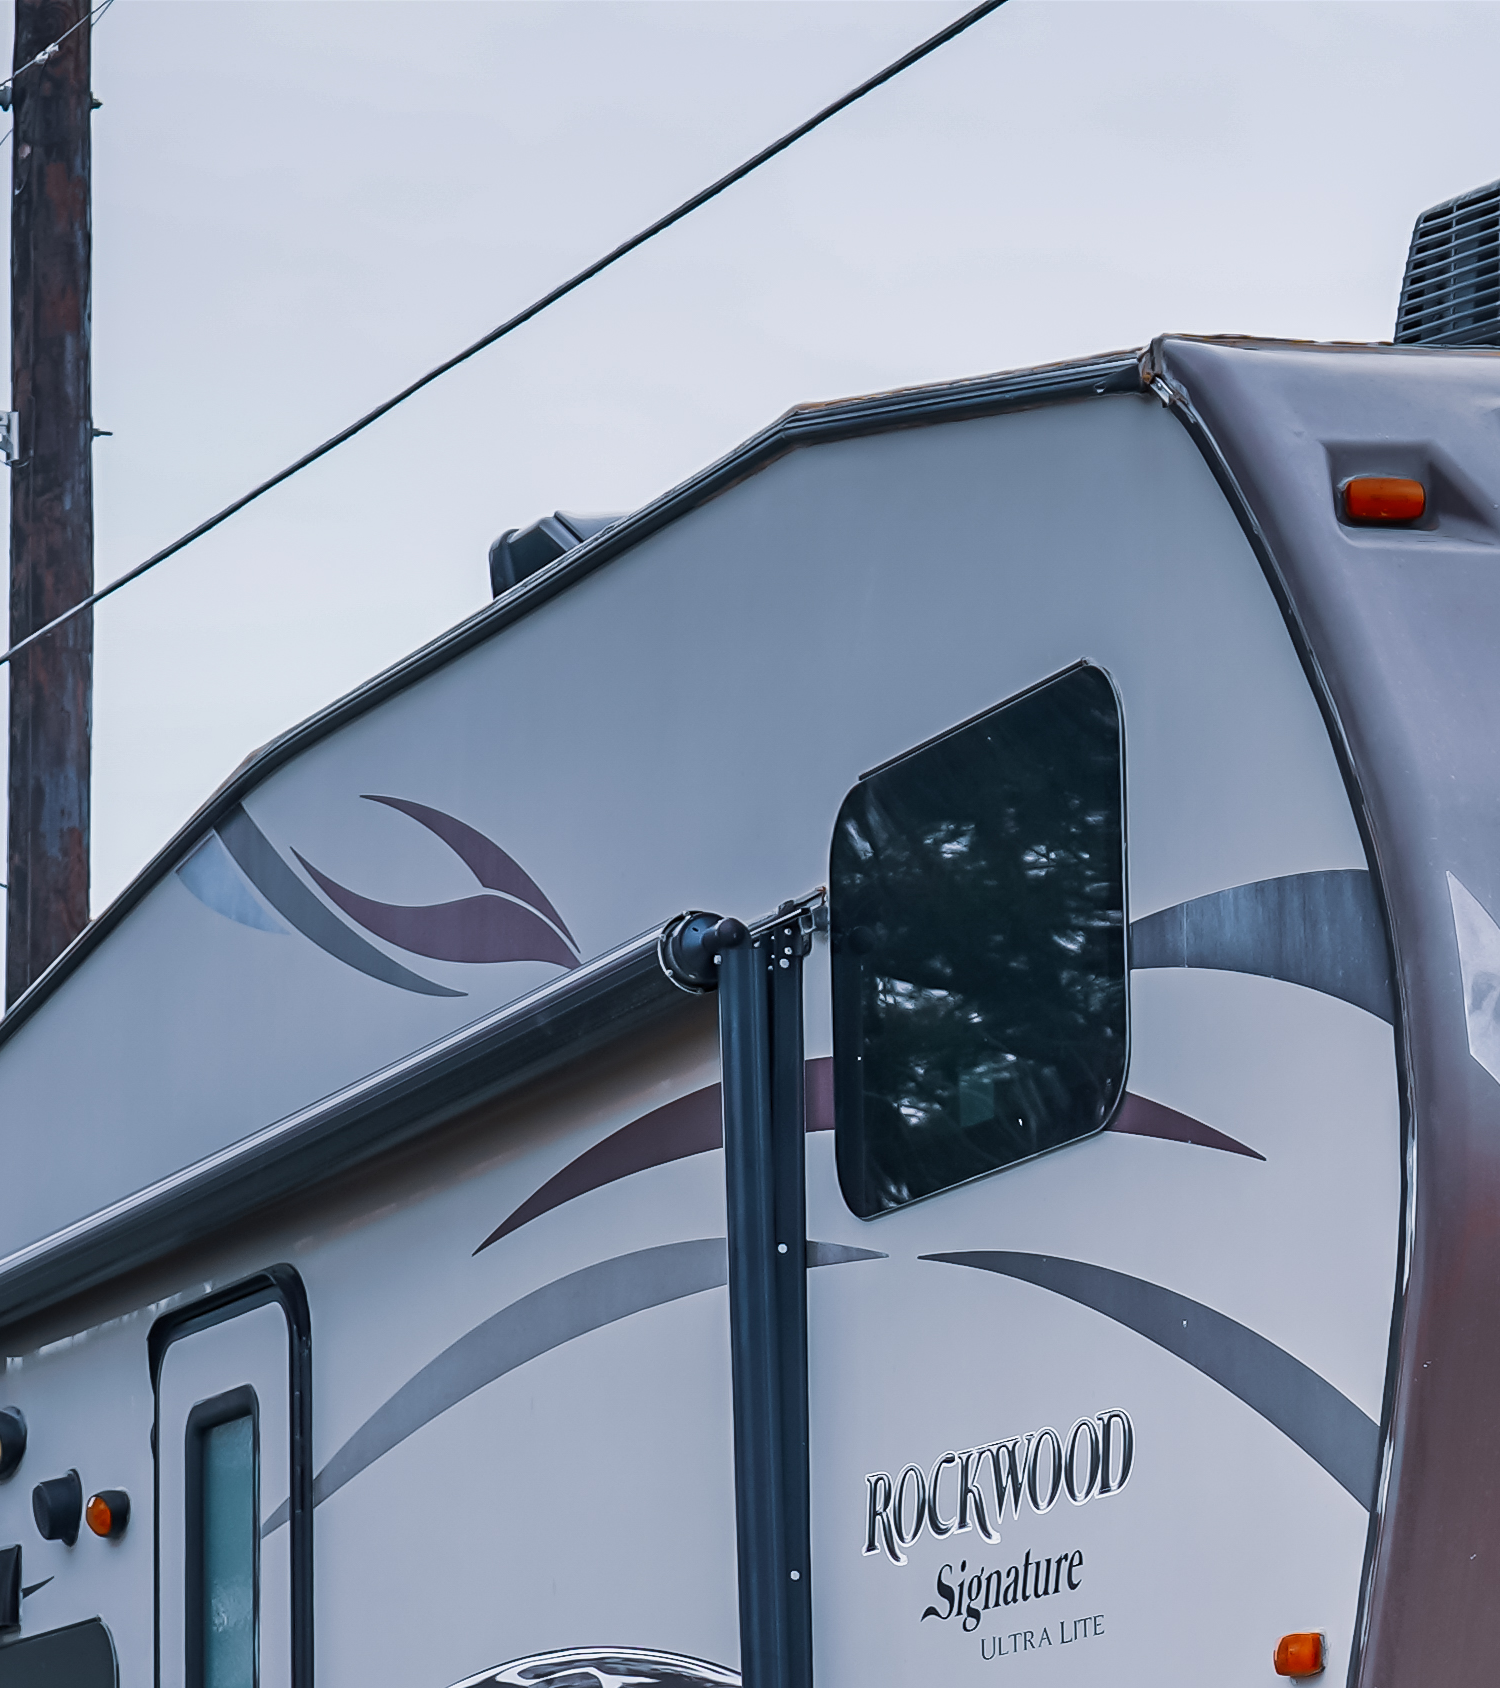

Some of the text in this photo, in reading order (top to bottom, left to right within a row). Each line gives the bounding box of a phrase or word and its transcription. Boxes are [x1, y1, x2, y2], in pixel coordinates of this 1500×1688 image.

[862, 1407, 1136, 1566] ROCKWOOD
[920, 1548, 1084, 1633] Signature
[980, 1614, 1106, 1661] ULTRA LITE
